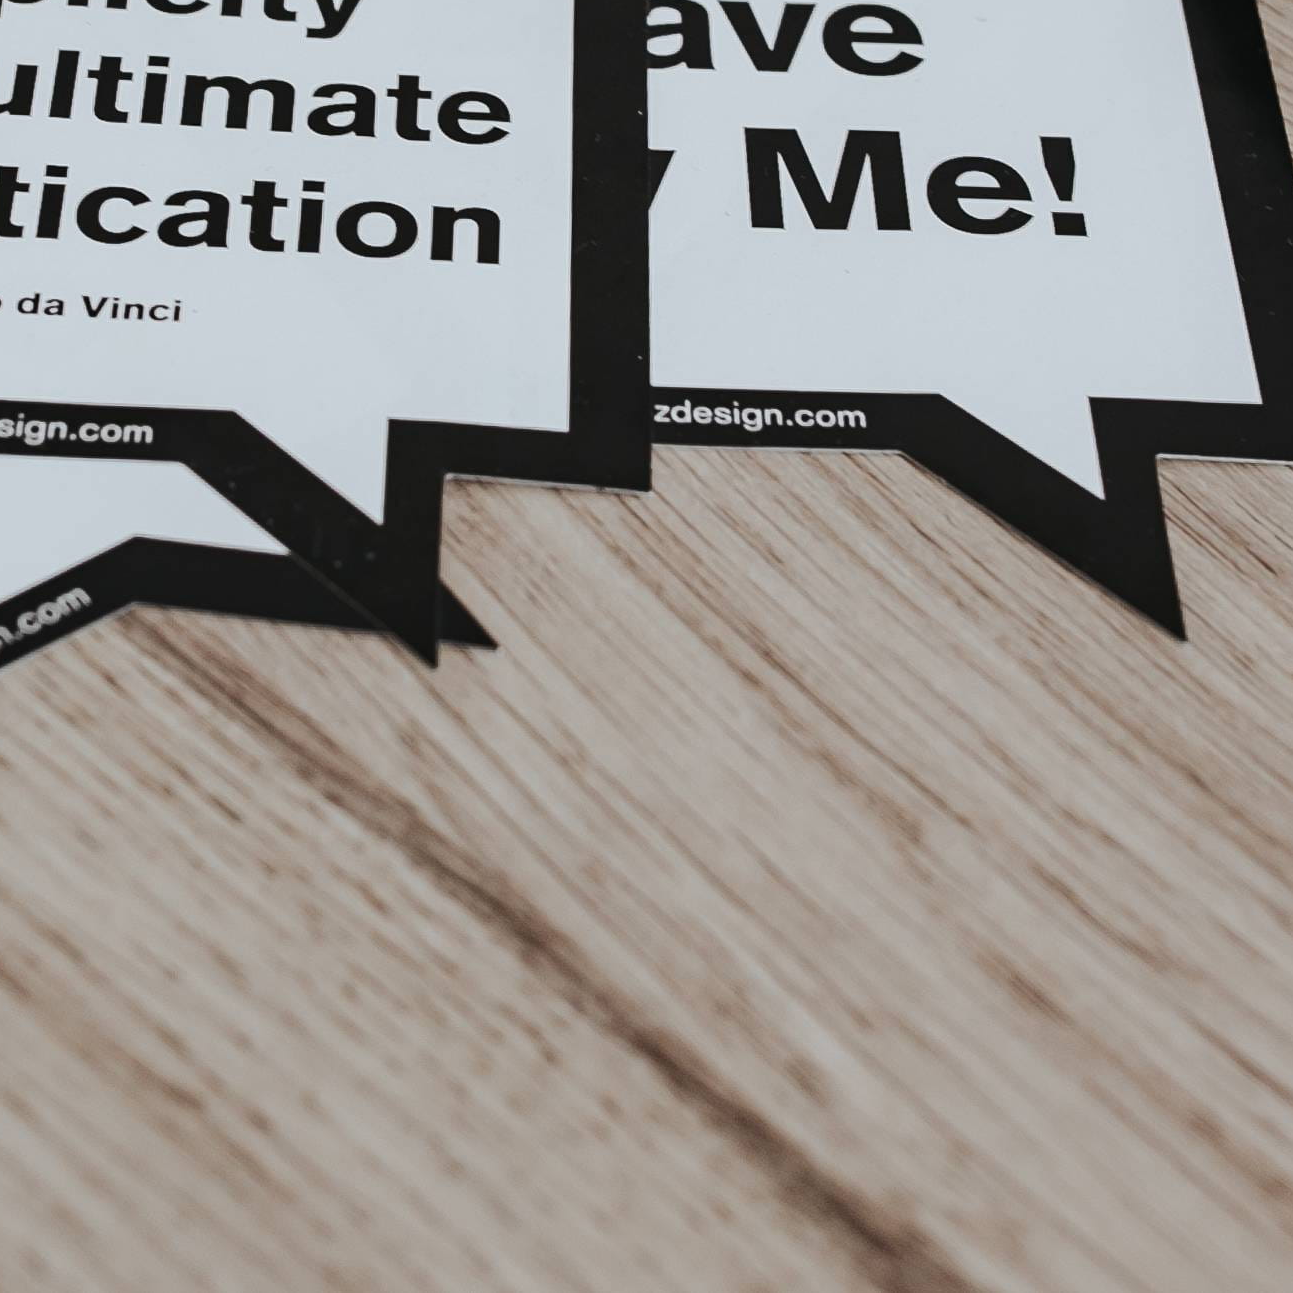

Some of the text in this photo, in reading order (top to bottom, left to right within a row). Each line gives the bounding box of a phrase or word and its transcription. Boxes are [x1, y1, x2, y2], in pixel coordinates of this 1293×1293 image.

[743, 125, 1089, 238] Me!
[16, 291, 65, 317] da
[81, 294, 183, 324] Vinci
